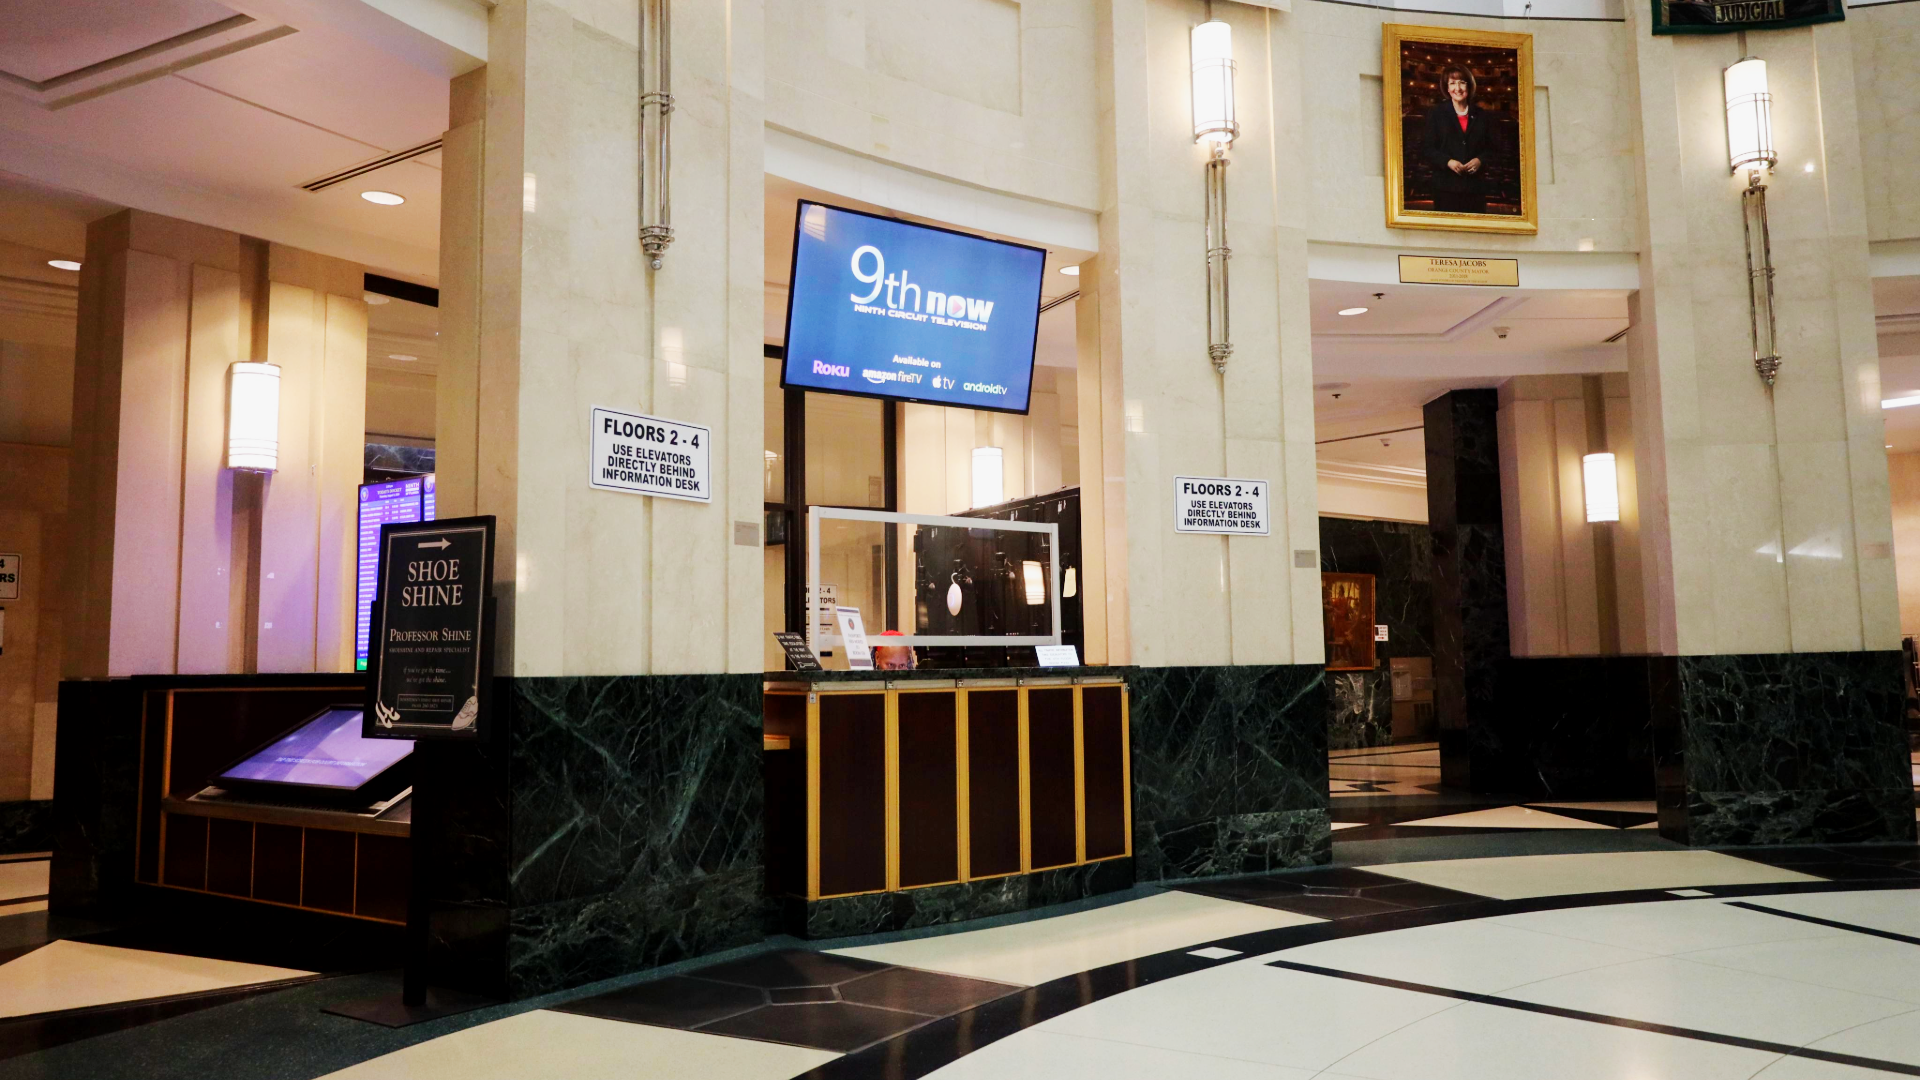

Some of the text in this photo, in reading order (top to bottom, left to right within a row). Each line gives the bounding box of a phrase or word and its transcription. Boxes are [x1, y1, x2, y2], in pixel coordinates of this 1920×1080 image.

[1717, 1, 1784, 21] JUDICIAL
[851, 245, 995, 323] 9th now
[854, 304, 987, 331] NINTH CIRCUIT TELEVISION
[892, 354, 942, 369] Available on
[862, 369, 897, 382] amazon
[942, 376, 955, 390] tv
[604, 417, 665, 443] FLOORS
[670, 430, 678, 445] 2
[691, 434, 699, 449] 4
[613, 443, 691, 466] USE ELEVATORS
[608, 455, 695, 479] DIRECTLY BEHIND
[602, 467, 700, 492] INFORMATION DESK
[1183, 482, 1231, 496] FLOORS
[1235, 485, 1242, 496] 2
[1252, 486, 1259, 497] 4
[1187, 509, 1256, 519] DIRECTLY BEHIND
[1191, 500, 1253, 510] USE ELEVATORS
[1184, 518, 1261, 528] INFORMATION DESK
[408, 559, 460, 582] SHOE
[402, 584, 463, 607] SHINE
[390, 627, 472, 642] PROFESSOR SHINE
